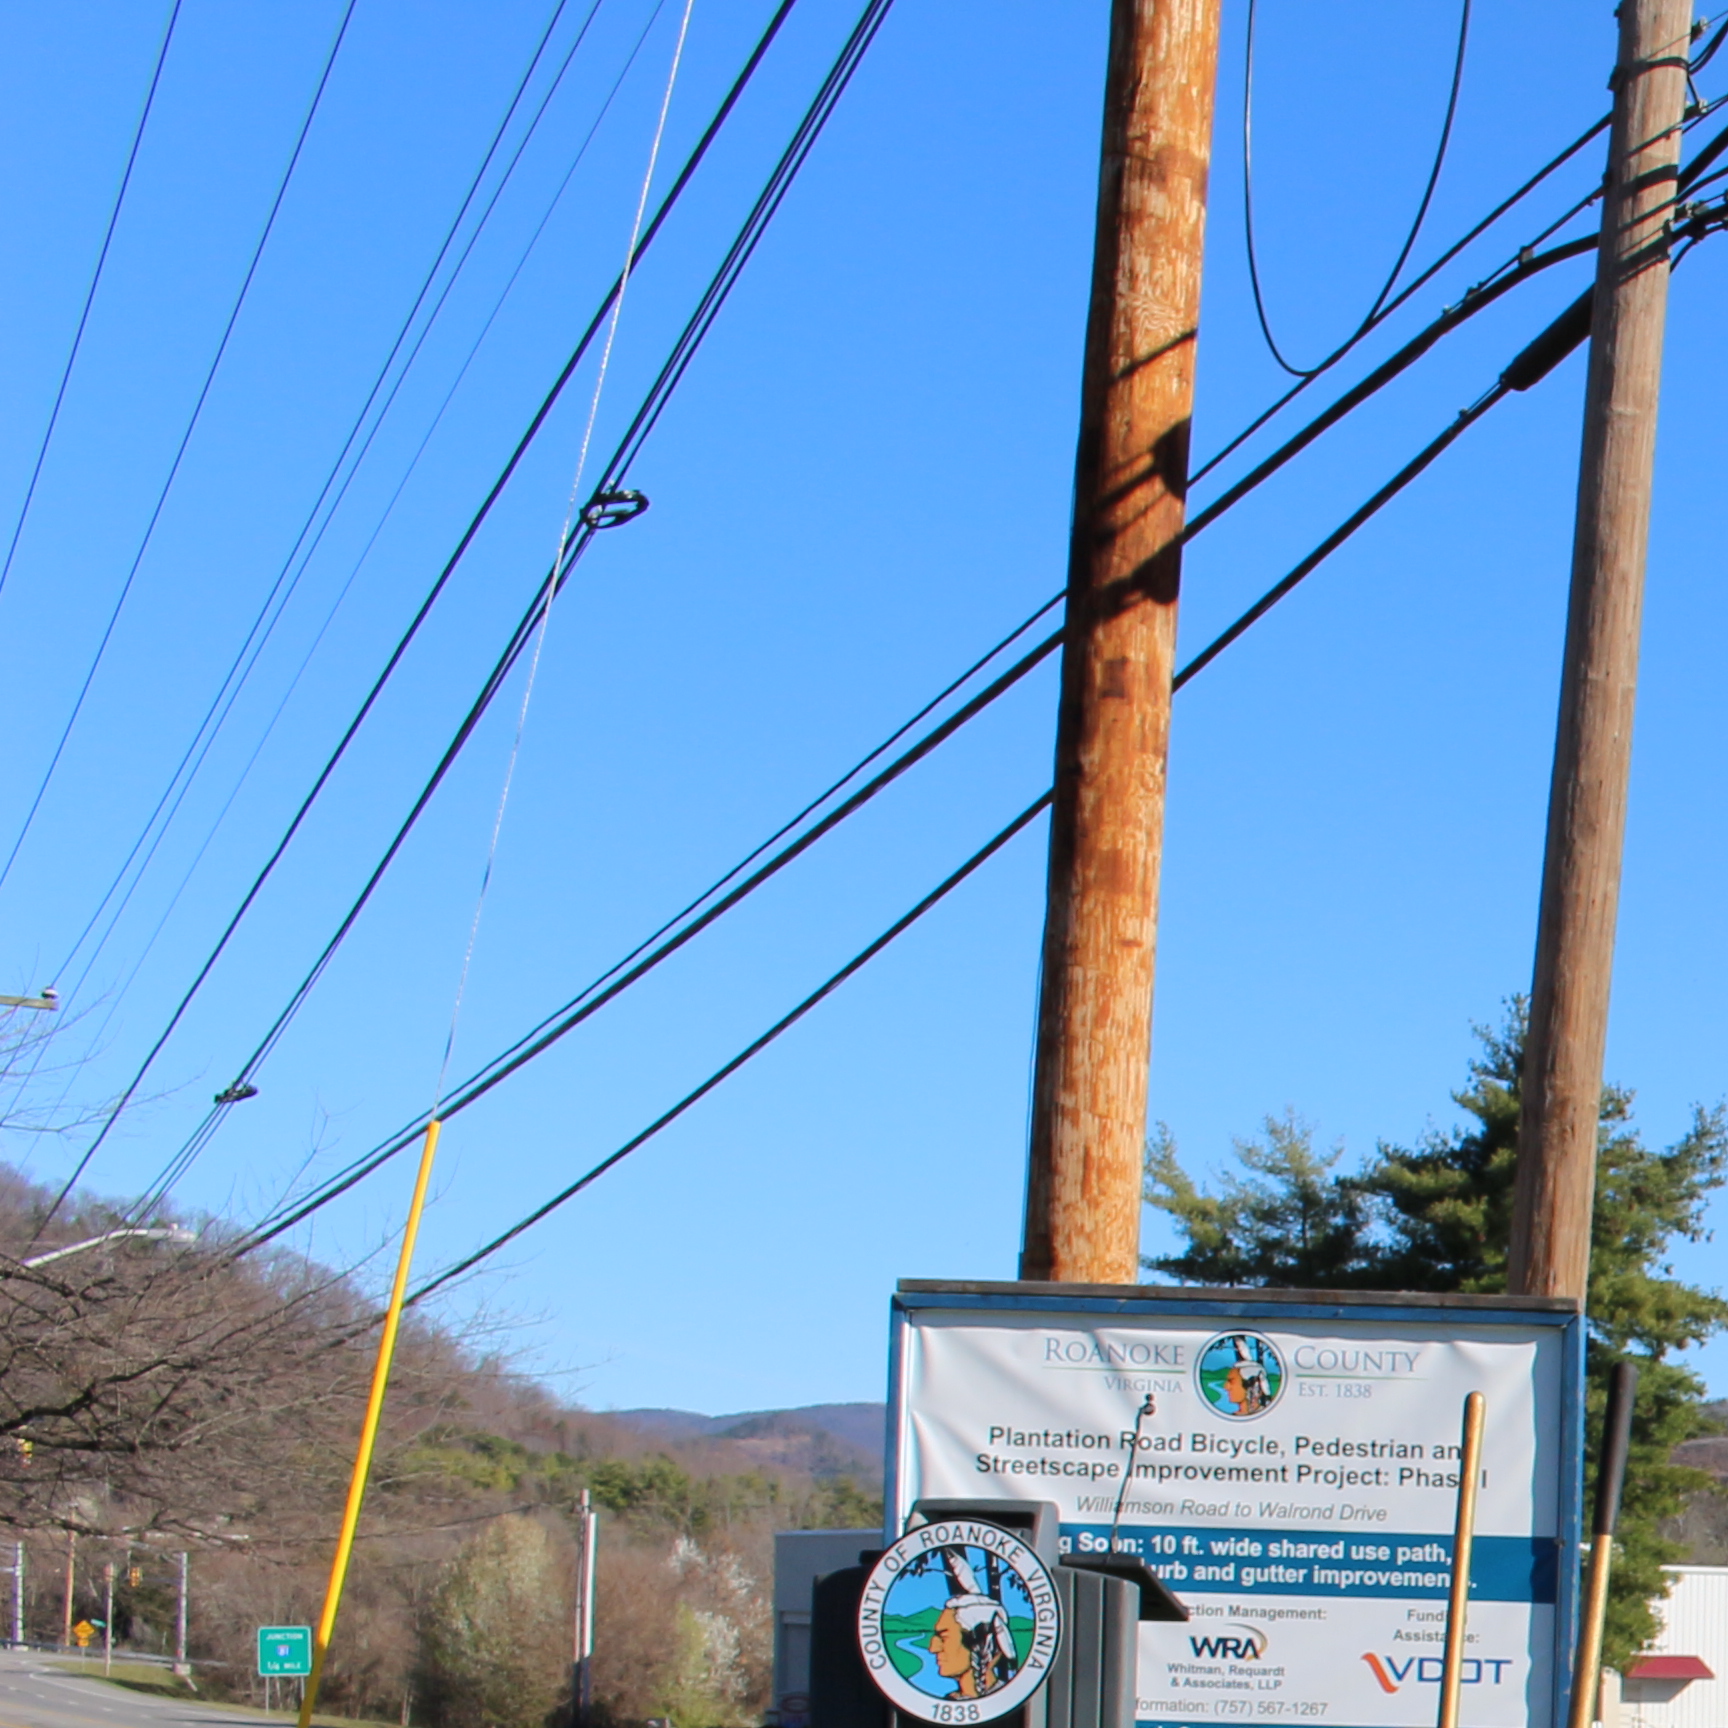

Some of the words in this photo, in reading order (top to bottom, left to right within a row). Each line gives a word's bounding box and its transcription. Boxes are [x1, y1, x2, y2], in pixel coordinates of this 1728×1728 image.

[1044, 1337, 1185, 1366] ROANOKE
[1294, 1344, 1421, 1373] COUNTY
[1103, 1376, 1184, 1394] VIRGINIA
[1299, 1382, 1328, 1398] EST.
[1335, 1384, 1372, 1399] 1838
[989, 1426, 1111, 1449] Plantation
[1120, 1431, 1183, 1451] Road
[1191, 1433, 1286, 1458] Bicycle,
[1294, 1436, 1423, 1459] Pedestrian
[1432, 1444, 1462, 1460] an
[976, 1454, 1120, 1481] Streetscape
[1296, 1464, 1390, 1489] Project:
[1399, 1467, 1461, 1488] Phas
[1077, 1496, 1175, 1515] Williamson
[1180, 1498, 1230, 1517] Road
[1235, 1503, 1251, 1518] to
[1259, 1502, 1334, 1521] Walrond
[1339, 1504, 1388, 1521] Drive
[1151, 1535, 1177, 1554] 10
[1182, 1535, 1204, 1555] ft.
[1211, 1537, 1263, 1557] wide
[1268, 1539, 1345, 1560] shared
[1351, 1545, 1391, 1561] use
[1396, 1543, 1452, 1566] path,
[1150, 1561, 1188, 1580] urb
[1193, 1564, 1235, 1582] and
[1241, 1566, 1307, 1587] gutter
[1313, 1565, 1477, 1589] improvemen.
[862, 1580, 887, 1670] COUNTY
[884, 1543, 908, 1573] OF
[919, 1525, 1025, 1564] ROANOKE
[1026, 1568, 1056, 1671] VIRGINIA
[1228, 1605, 1327, 1622] Management:
[1189, 1636, 1261, 1660] WRA
[1393, 1629, 1480, 1643] Assistae:
[1167, 1663, 1225, 1677] Whitman,
[1229, 1665, 1285, 1679] Requardt
[1384, 1655, 1513, 1685] VDOT
[1170, 1677, 1180, 1687] &
[1183, 1678, 1253, 1690] Associates,
[1258, 1680, 1282, 1690] LLP
[931, 1703, 980, 1722] 1838
[1136, 1697, 1209, 1713] formation:
[1214, 1700, 1252, 1716] (757)
[1257, 1701, 1328, 1716] 567-1267
